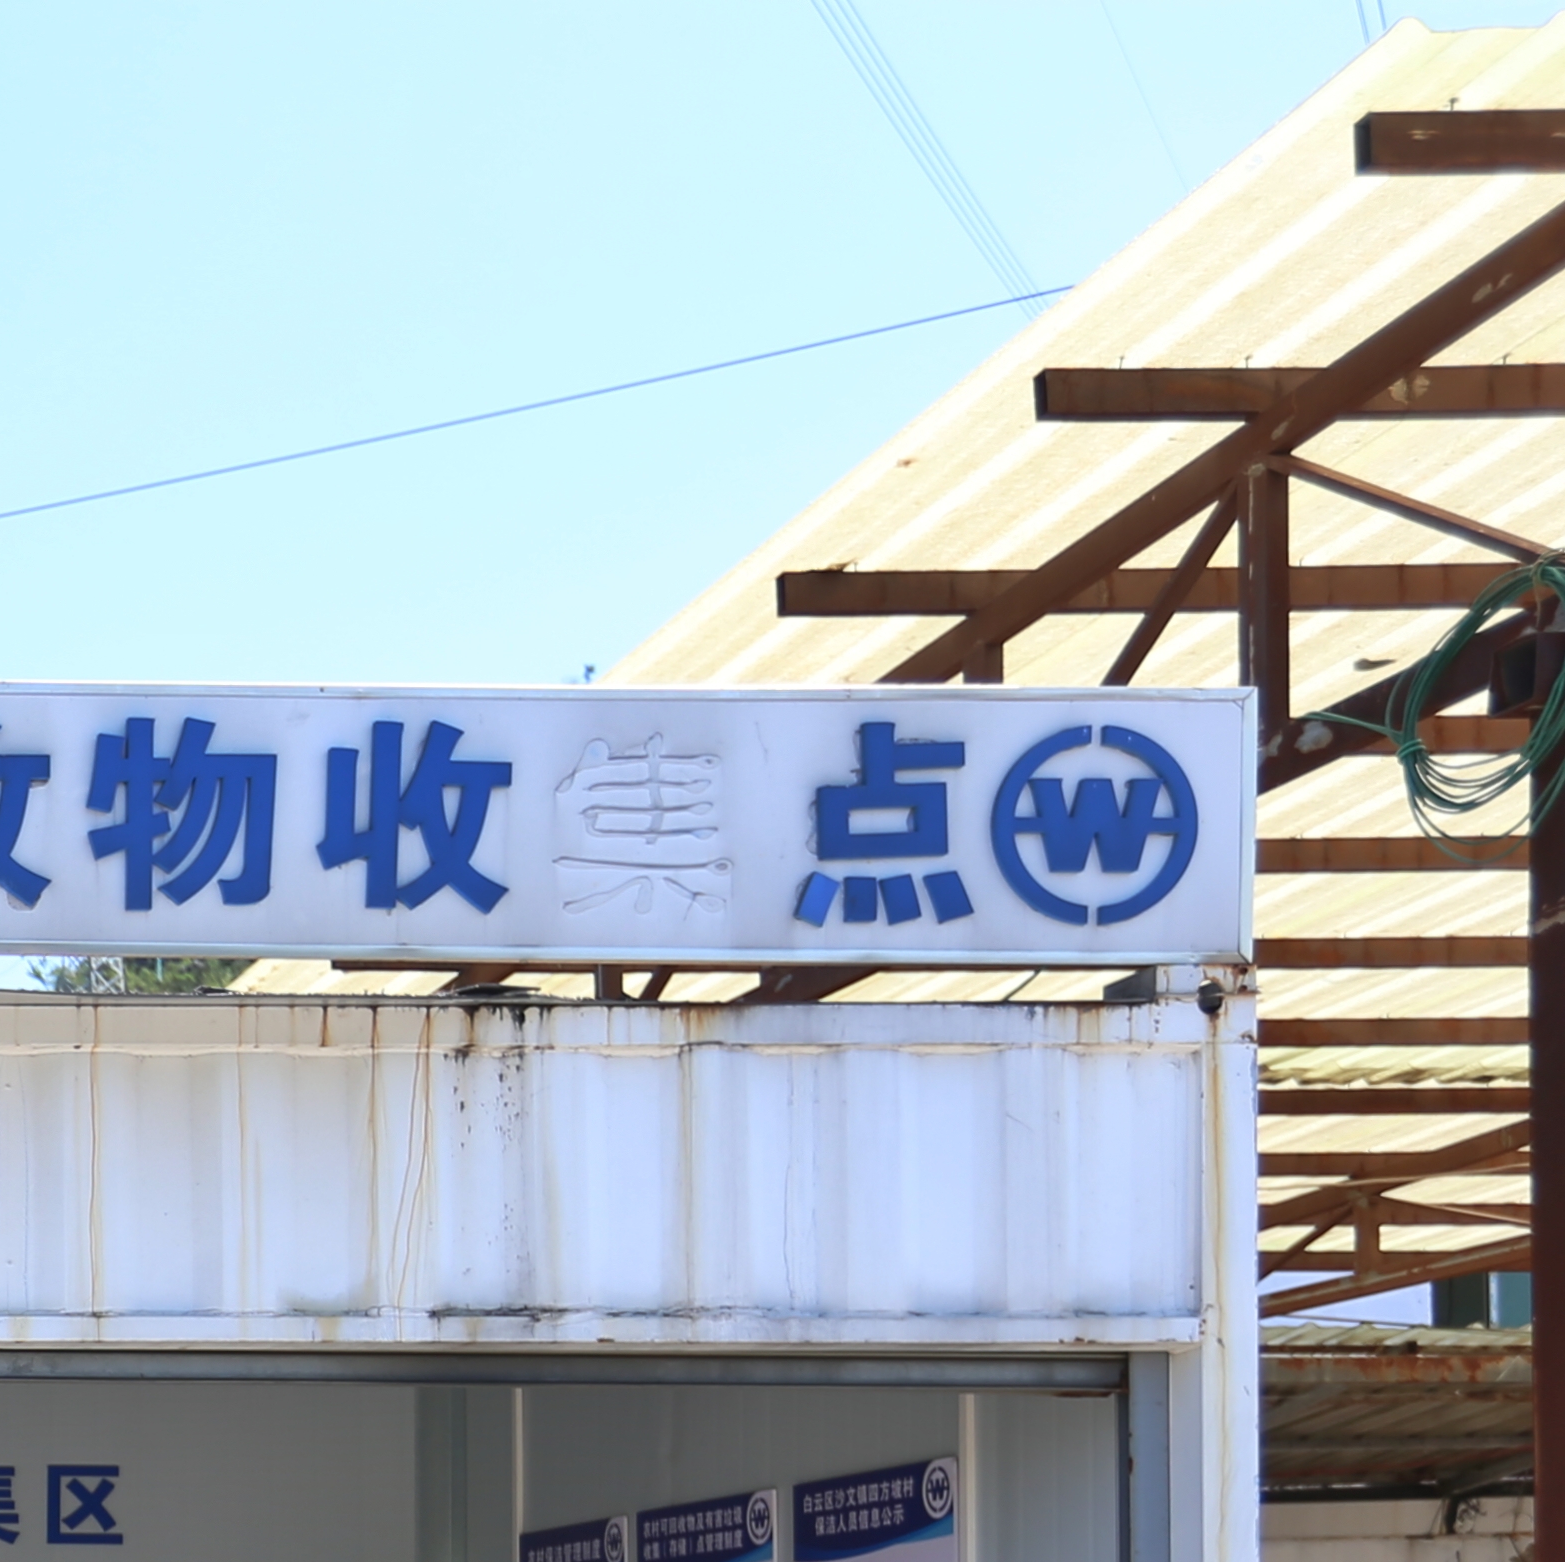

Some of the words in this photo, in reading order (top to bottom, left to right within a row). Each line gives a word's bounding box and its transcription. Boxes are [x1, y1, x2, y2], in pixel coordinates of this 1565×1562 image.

[803, 1476, 915, 1514] 白云区沙文镇四方坡村
[814, 1503, 905, 1537] 保洁人员信息公示
